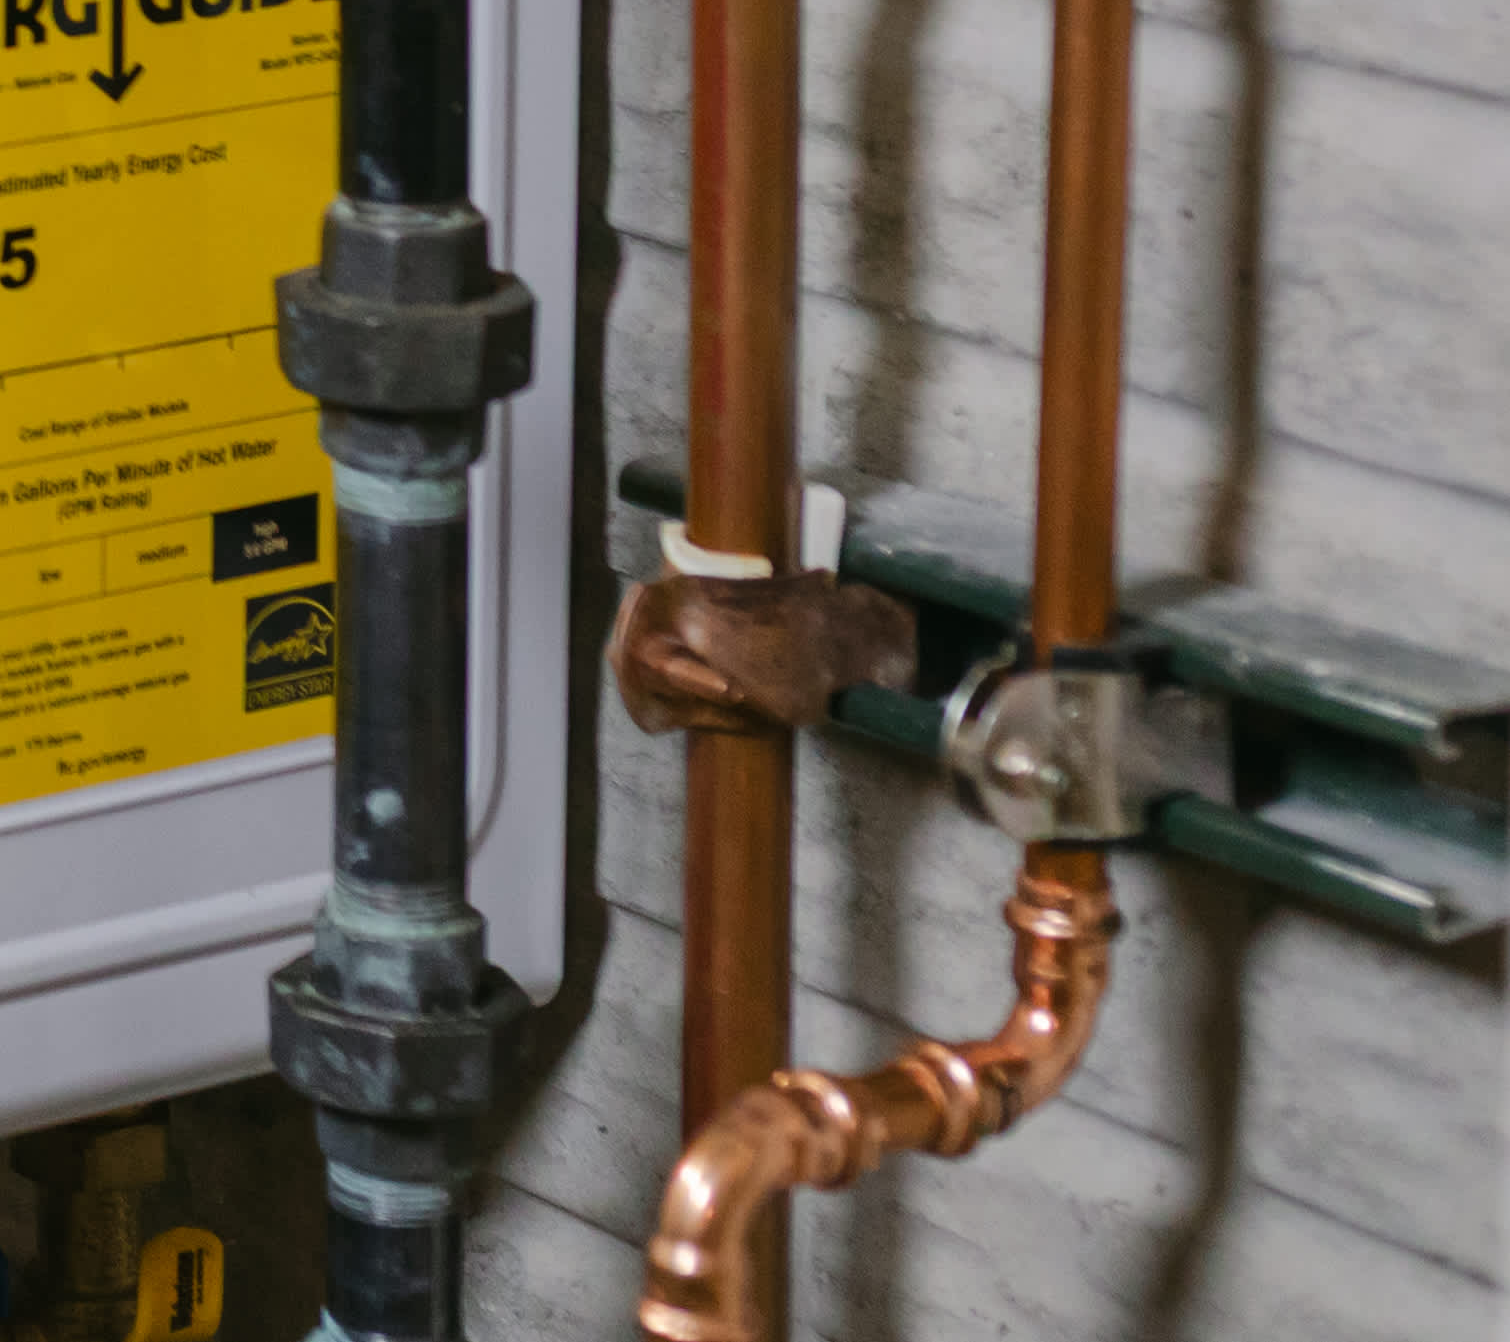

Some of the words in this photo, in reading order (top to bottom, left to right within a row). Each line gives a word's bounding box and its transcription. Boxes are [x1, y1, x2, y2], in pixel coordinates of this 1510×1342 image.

[72, 159, 121, 184] Yearly
[126, 152, 184, 176] Energy
[187, 142, 227, 165] Cost
[12, 475, 79, 503] Gallons
[82, 468, 113, 490] Per
[115, 458, 172, 484] Minute
[175, 450, 196, 474] of
[198, 445, 228, 468] Hot
[230, 437, 280, 463] Water
